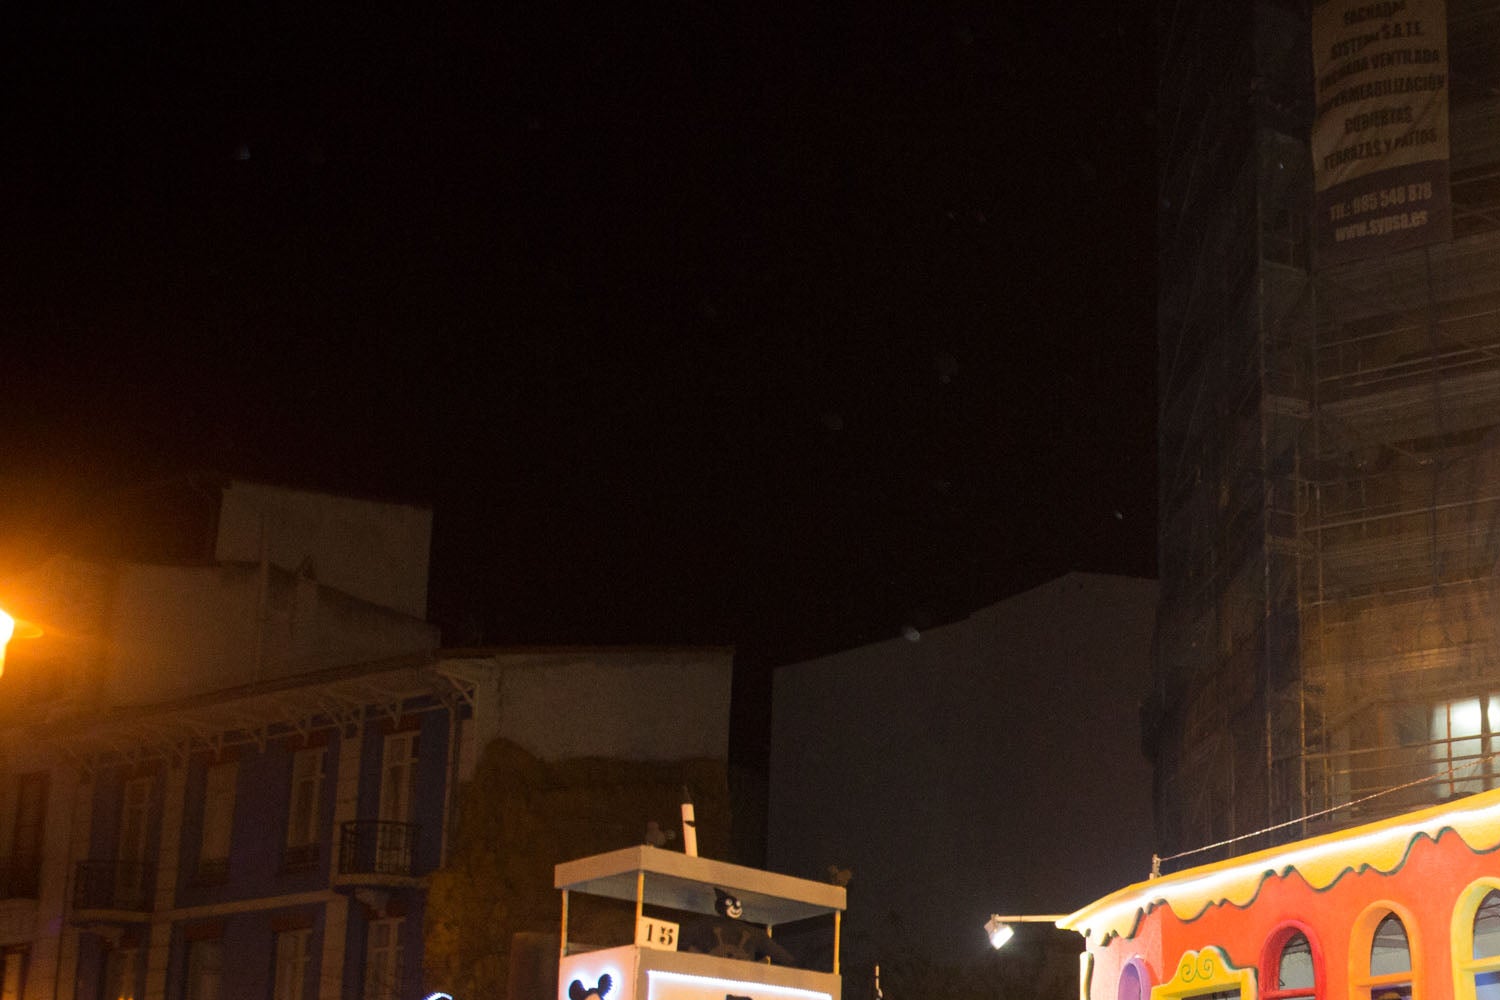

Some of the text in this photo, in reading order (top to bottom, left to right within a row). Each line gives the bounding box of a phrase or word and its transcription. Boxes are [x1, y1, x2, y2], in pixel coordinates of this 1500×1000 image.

[1324, 139, 1382, 170] TERRAZAS
[1384, 138, 1393, 152] Y
[645, 923, 675, 947] 15
